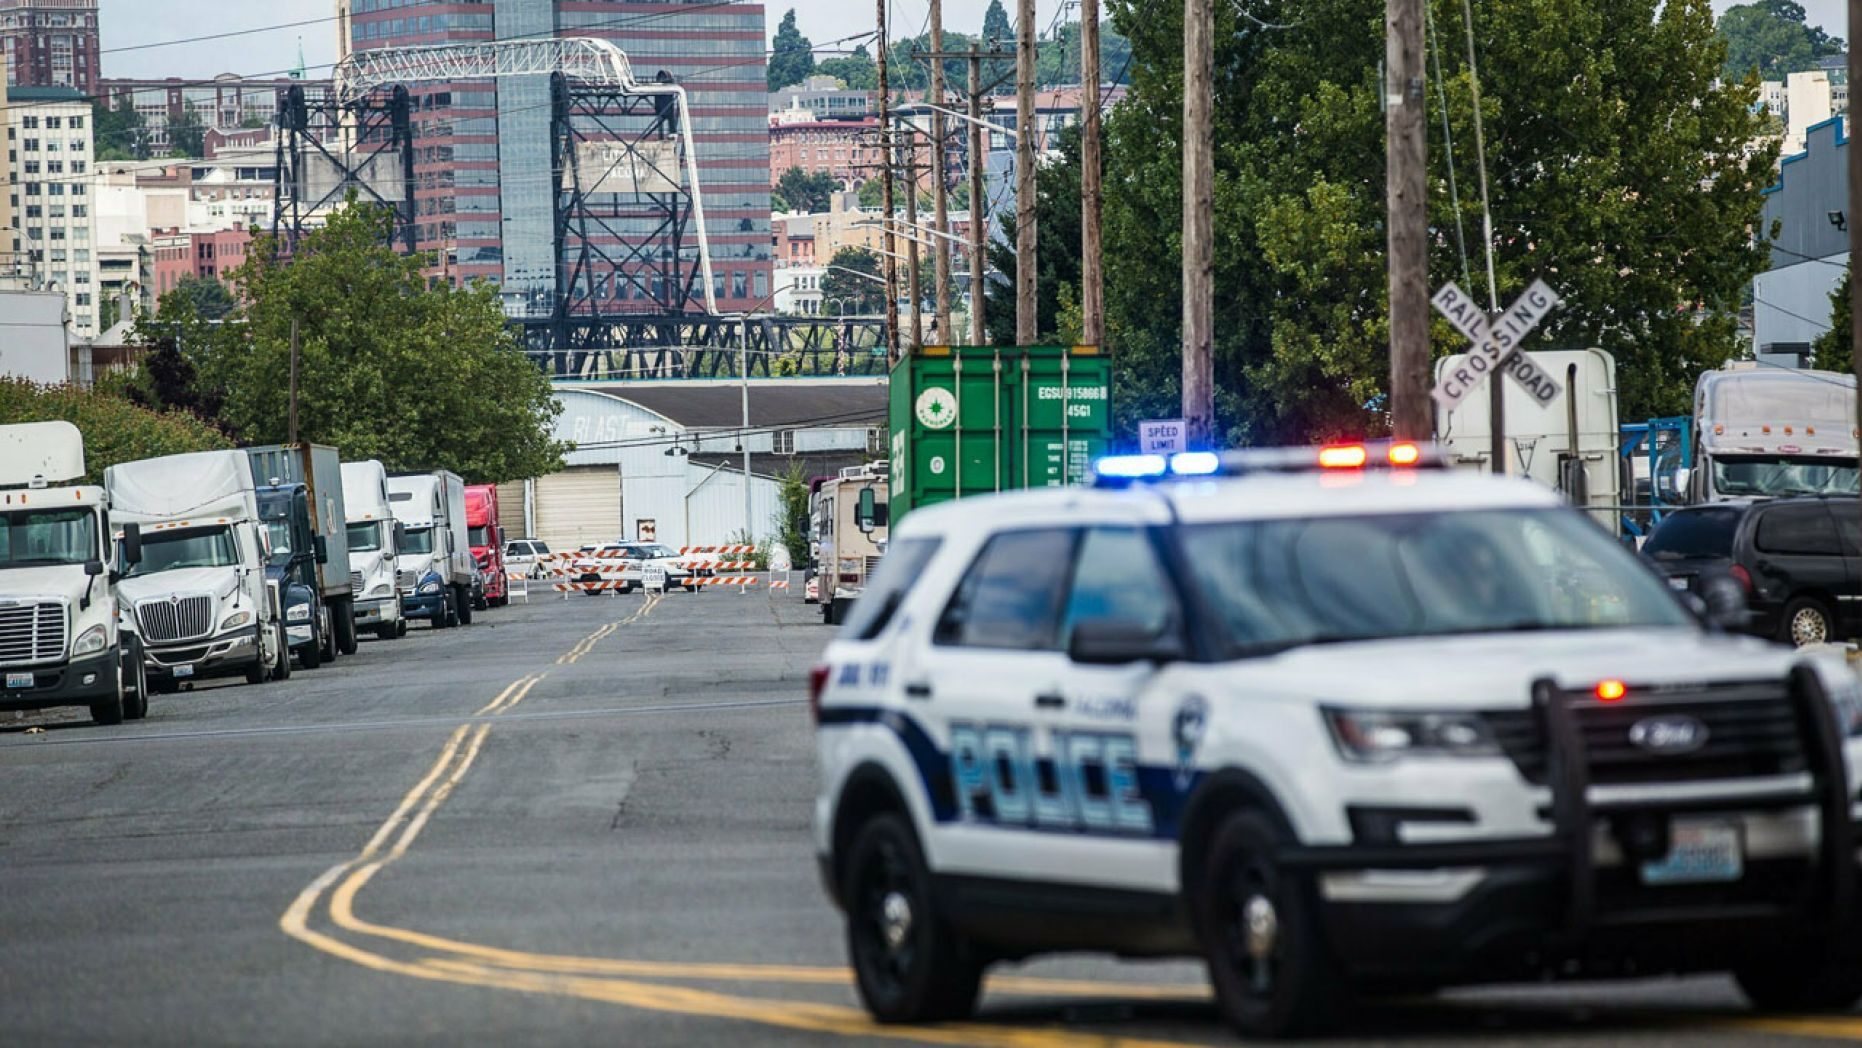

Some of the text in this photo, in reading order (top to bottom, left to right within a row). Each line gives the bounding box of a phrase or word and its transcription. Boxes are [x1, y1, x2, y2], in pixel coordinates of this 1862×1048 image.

[1439, 289, 1483, 338] RAIL
[1445, 291, 1547, 398] CROSSING
[1509, 353, 1554, 400] ROAD
[1067, 405, 1090, 416] 45G1
[1148, 427, 1178, 437] SPEED
[1151, 440, 1174, 450] LIMIT
[950, 722, 1154, 834] POLICE
